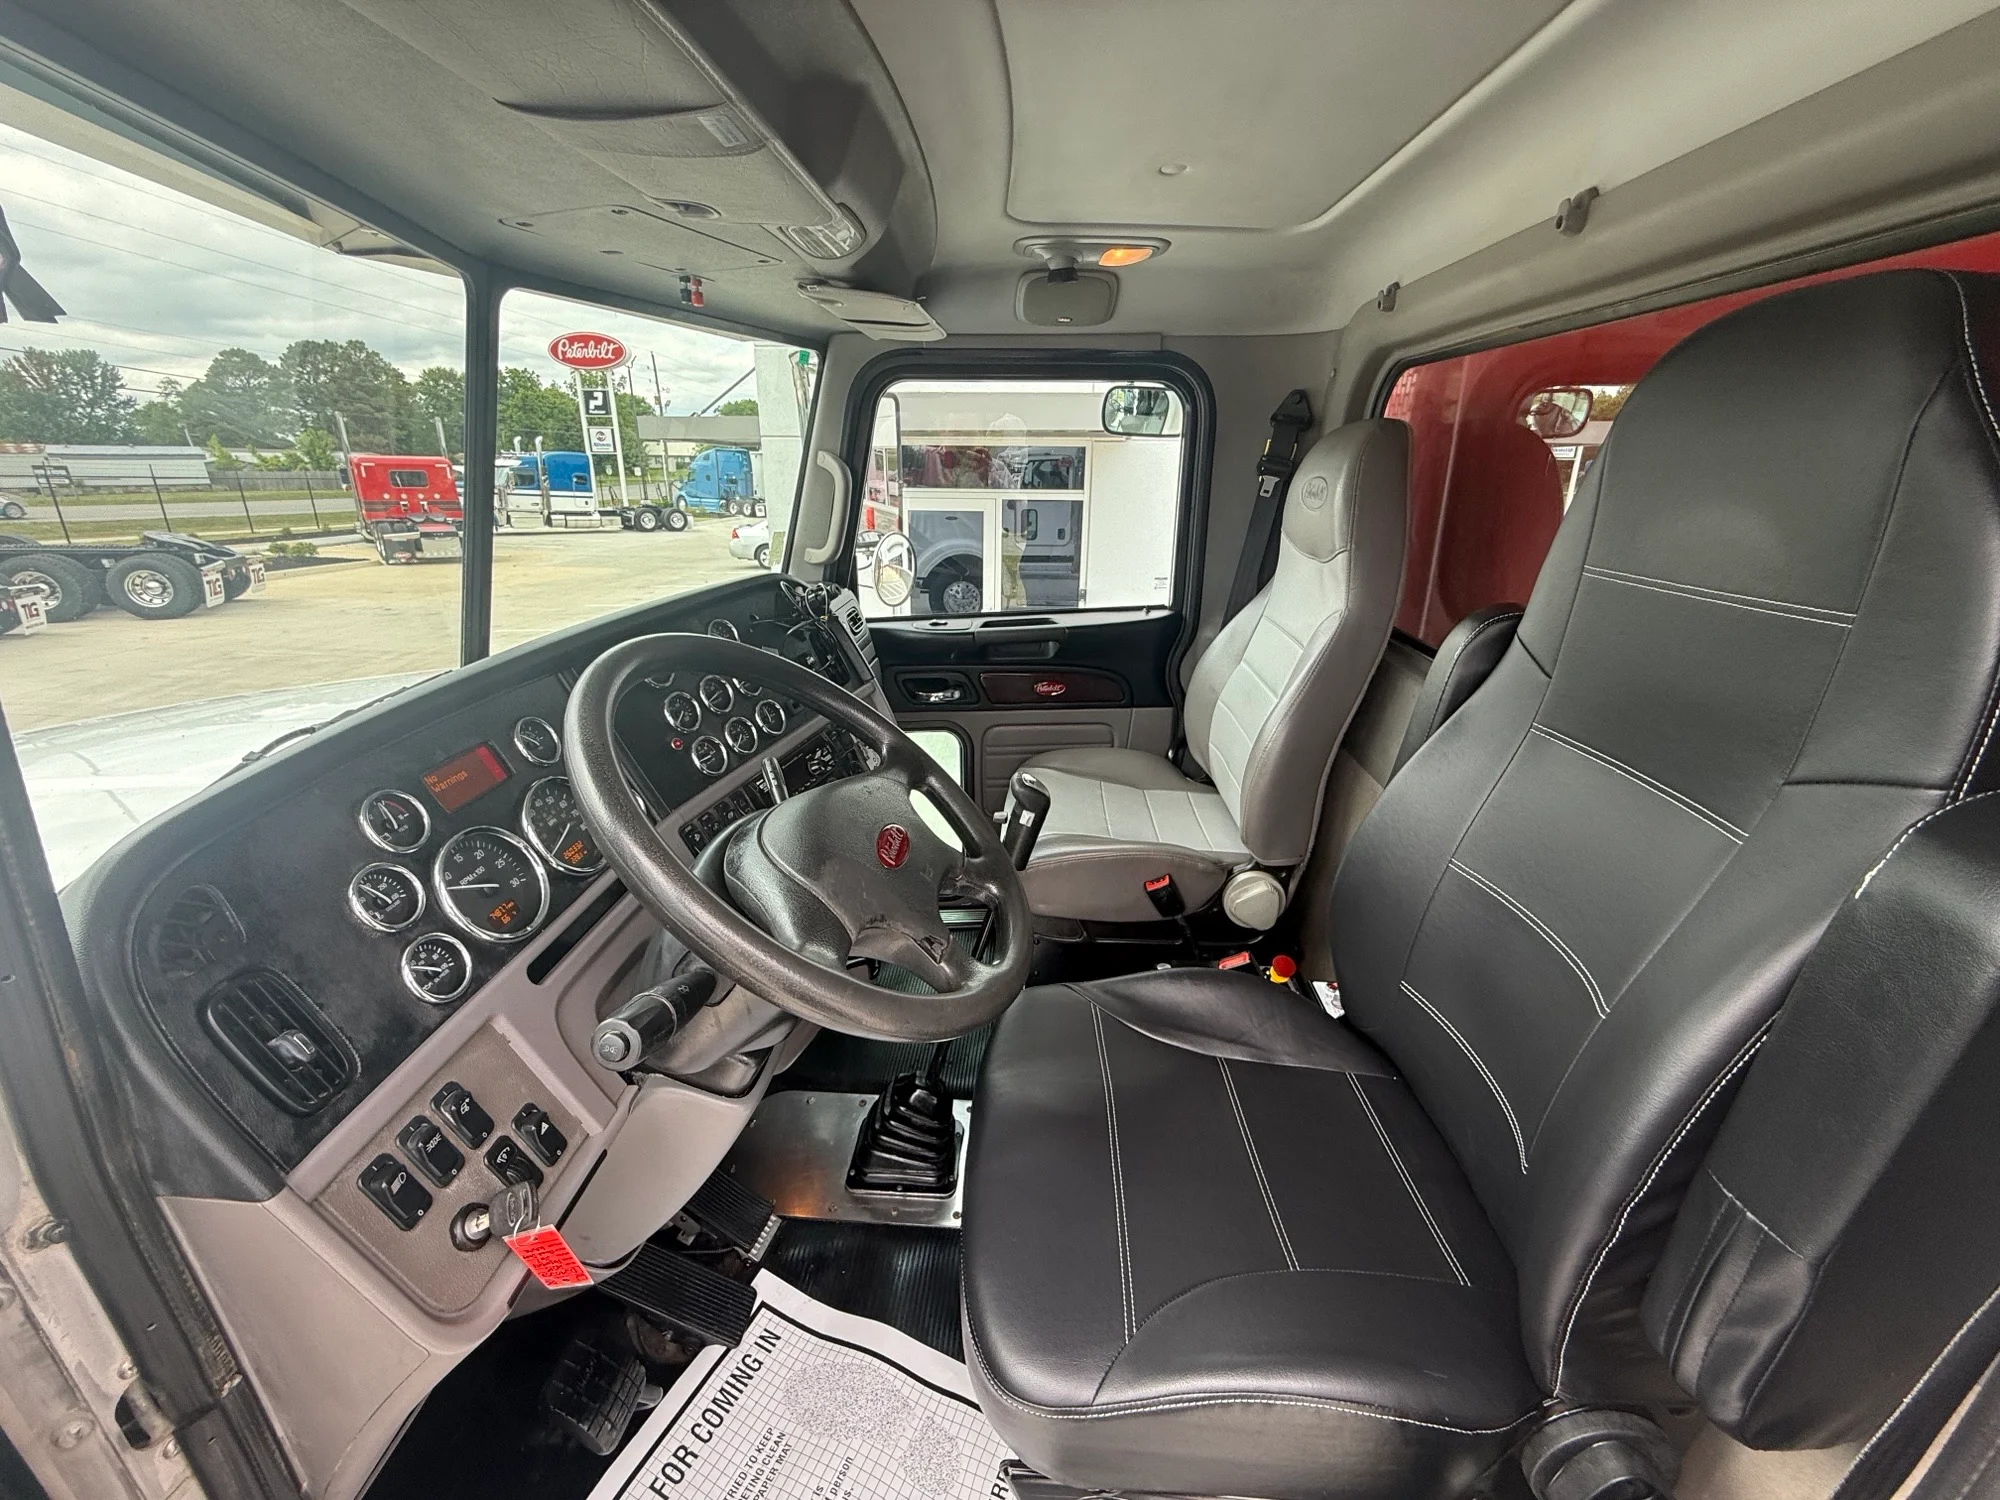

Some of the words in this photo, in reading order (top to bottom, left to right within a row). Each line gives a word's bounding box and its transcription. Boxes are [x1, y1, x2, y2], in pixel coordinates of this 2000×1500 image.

[557, 338, 619, 360] Peterbilt
[423, 775, 438, 785] No
[431, 770, 469, 793] Warnings
[453, 853, 464, 863] 15
[473, 849, 485, 860] 20
[495, 858, 506, 869] 25
[509, 877, 520, 888] 30
[649, 1444, 699, 1500] FOR
[690, 1353, 764, 1444] COMING
[754, 1328, 782, 1354] IN
[744, 1454, 758, 1469] TO
[755, 1427, 775, 1454] KEEP
[762, 1431, 786, 1467] CLEAN
[753, 1467, 779, 1500] PAPER
[776, 1442, 792, 1465] MAT
[829, 1456, 854, 1496] person
